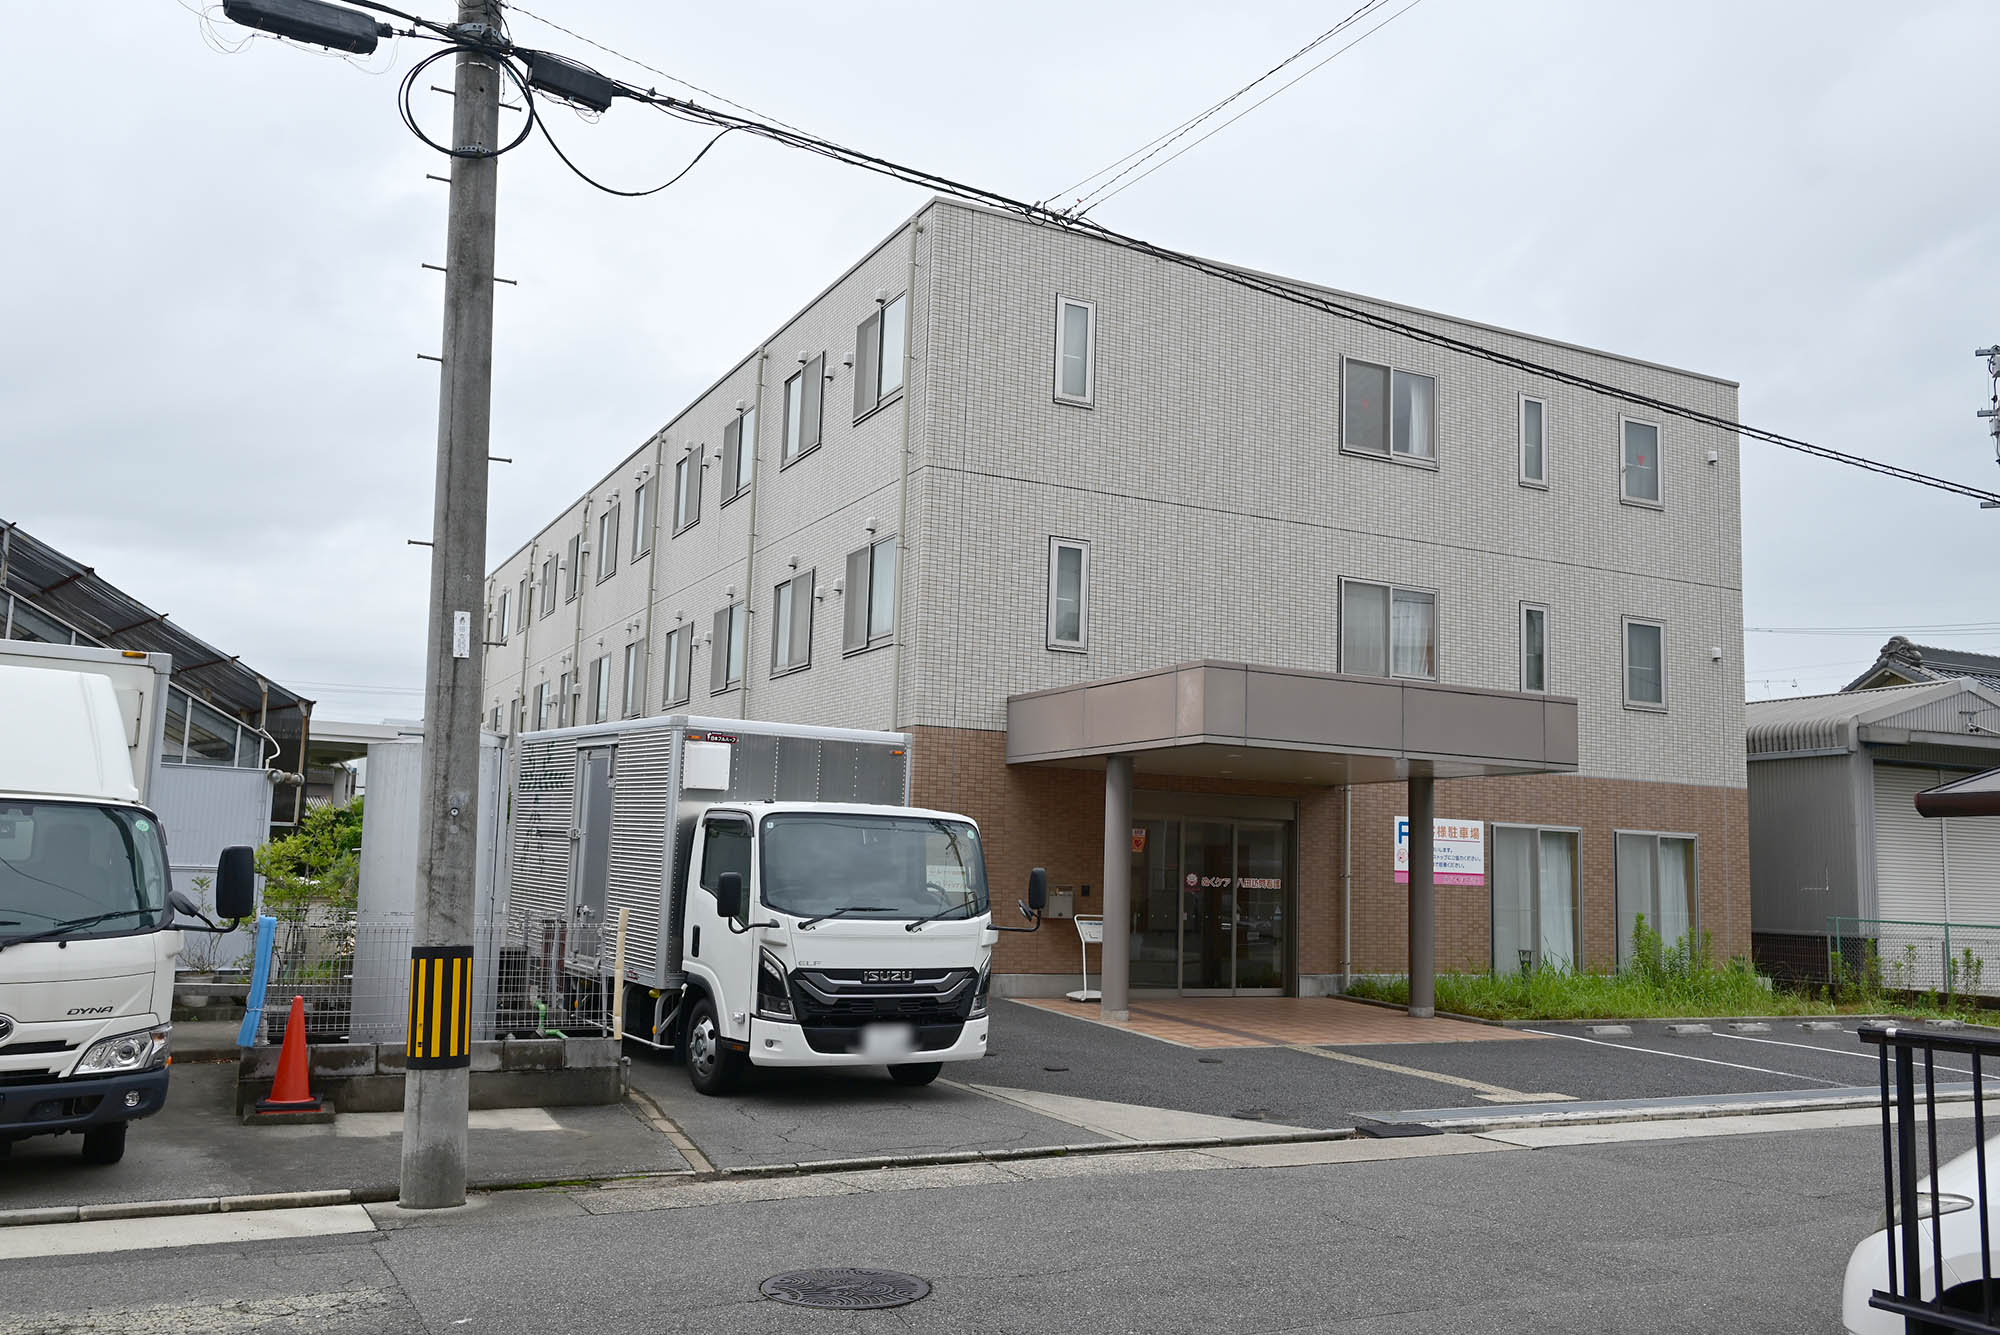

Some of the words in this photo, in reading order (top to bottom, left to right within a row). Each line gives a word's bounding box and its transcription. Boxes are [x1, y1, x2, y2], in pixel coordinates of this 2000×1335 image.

[1433, 825, 1481, 840] 様駐車場
[864, 971, 912, 981] ISUZU
[67, 1006, 113, 1015] DYNA
